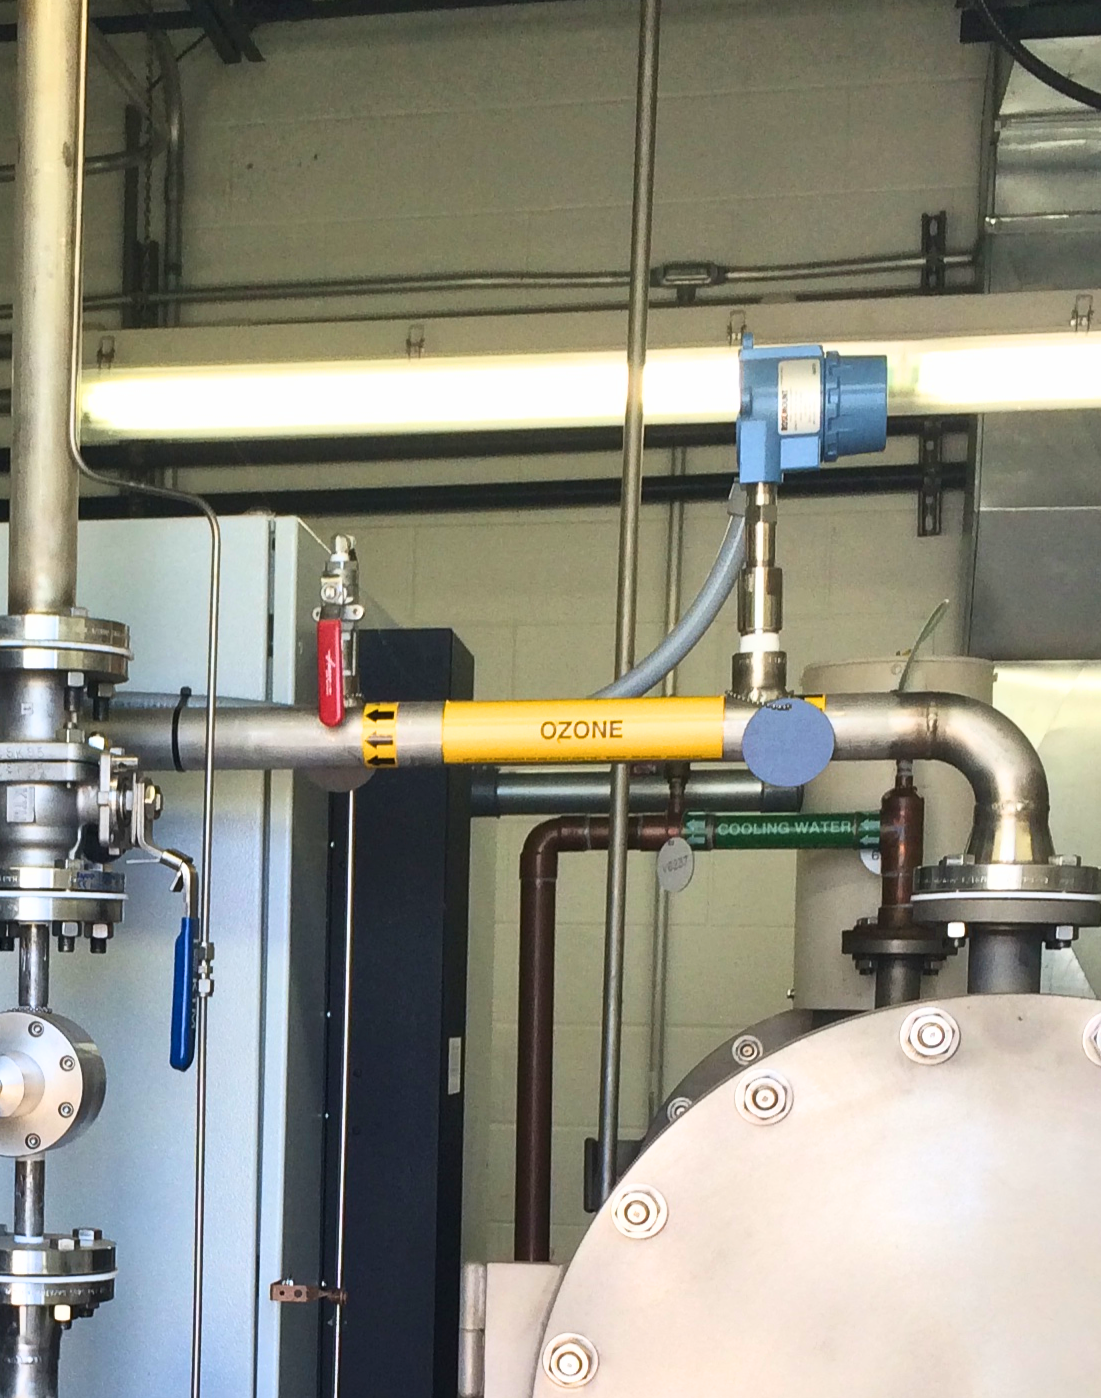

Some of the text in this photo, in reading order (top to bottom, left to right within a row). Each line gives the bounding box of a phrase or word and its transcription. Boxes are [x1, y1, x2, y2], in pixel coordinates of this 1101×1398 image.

[540, 720, 624, 740] OZONE
[717, 820, 852, 836] COOLING WATER
